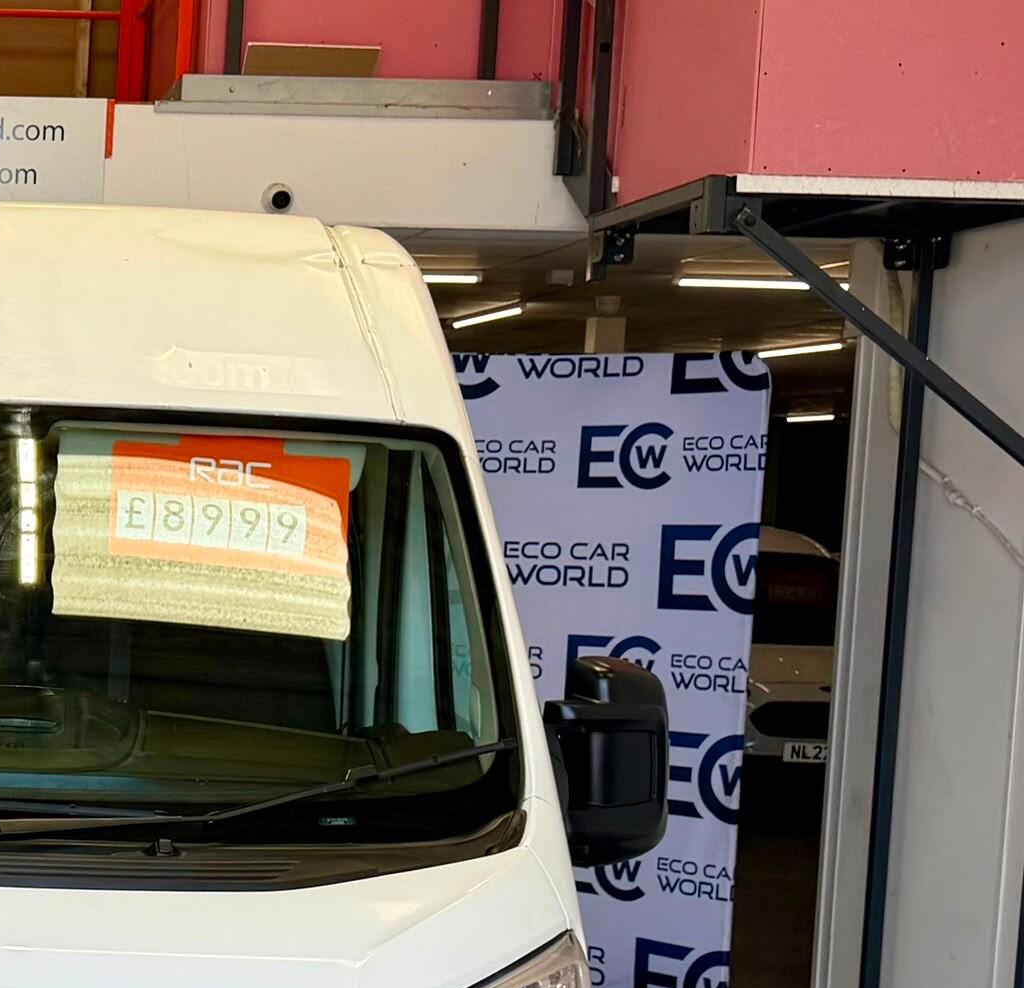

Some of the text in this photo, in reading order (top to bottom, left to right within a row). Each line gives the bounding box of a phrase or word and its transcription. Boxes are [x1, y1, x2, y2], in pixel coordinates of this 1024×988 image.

[517, 357, 644, 379] WORLD
[475, 439, 556, 454] CO CAR
[683, 436, 724, 451] ECO
[479, 457, 556, 474] ORLD
[124, 496, 299, 544] £8999
[503, 540, 629, 561] ECO CAR
[507, 564, 630, 588] WORLD
[671, 654, 747, 672] ECO CA
[671, 672, 745, 693] WORL
[657, 856, 732, 881] ECO CA
